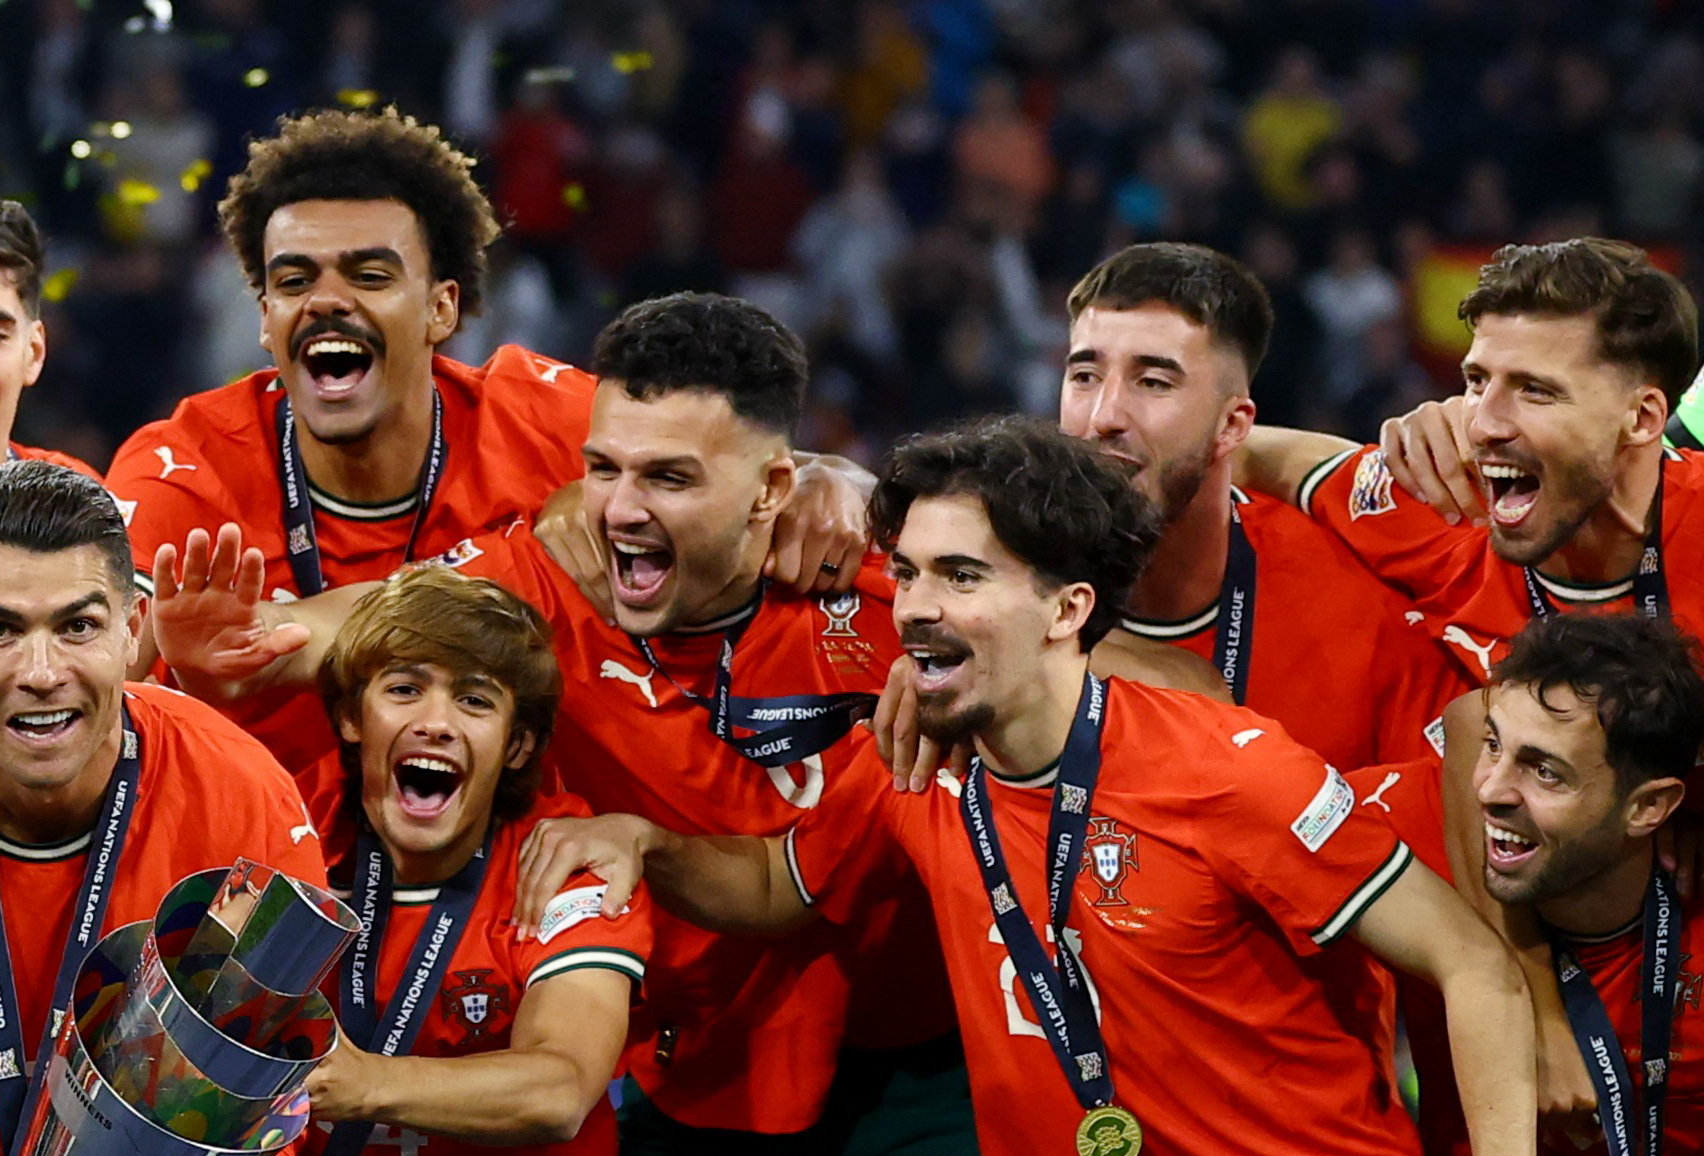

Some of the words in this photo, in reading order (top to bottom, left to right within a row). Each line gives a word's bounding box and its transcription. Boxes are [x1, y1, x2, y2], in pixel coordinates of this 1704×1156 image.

[1227, 587, 1244, 646] LEAGUE
[747, 708, 794, 720] LEAGUE
[744, 738, 793, 758] EAGUE
[110, 780, 128, 818] UEFA
[93, 819, 120, 883] NATIONS
[368, 852, 382, 888] UEFA
[977, 829, 995, 867] UEFA
[1054, 833, 1072, 869] UEFA
[77, 884, 101, 947] LEAGUE
[357, 888, 377, 951] NATIONS
[1050, 870, 1064, 918] NATIO
[351, 953, 367, 1008] LEAGUE
[395, 968, 430, 1027] NATIONS
[421, 913, 453, 968] LEAGUE
[1653, 939, 1667, 997] LEAGUE
[1030, 971, 1066, 1032] LEAGUE
[1589, 1036, 1620, 1093] LEAGUE
[65, 1069, 112, 1130] WINNERS
[1611, 1092, 1628, 1150] NATIONS
